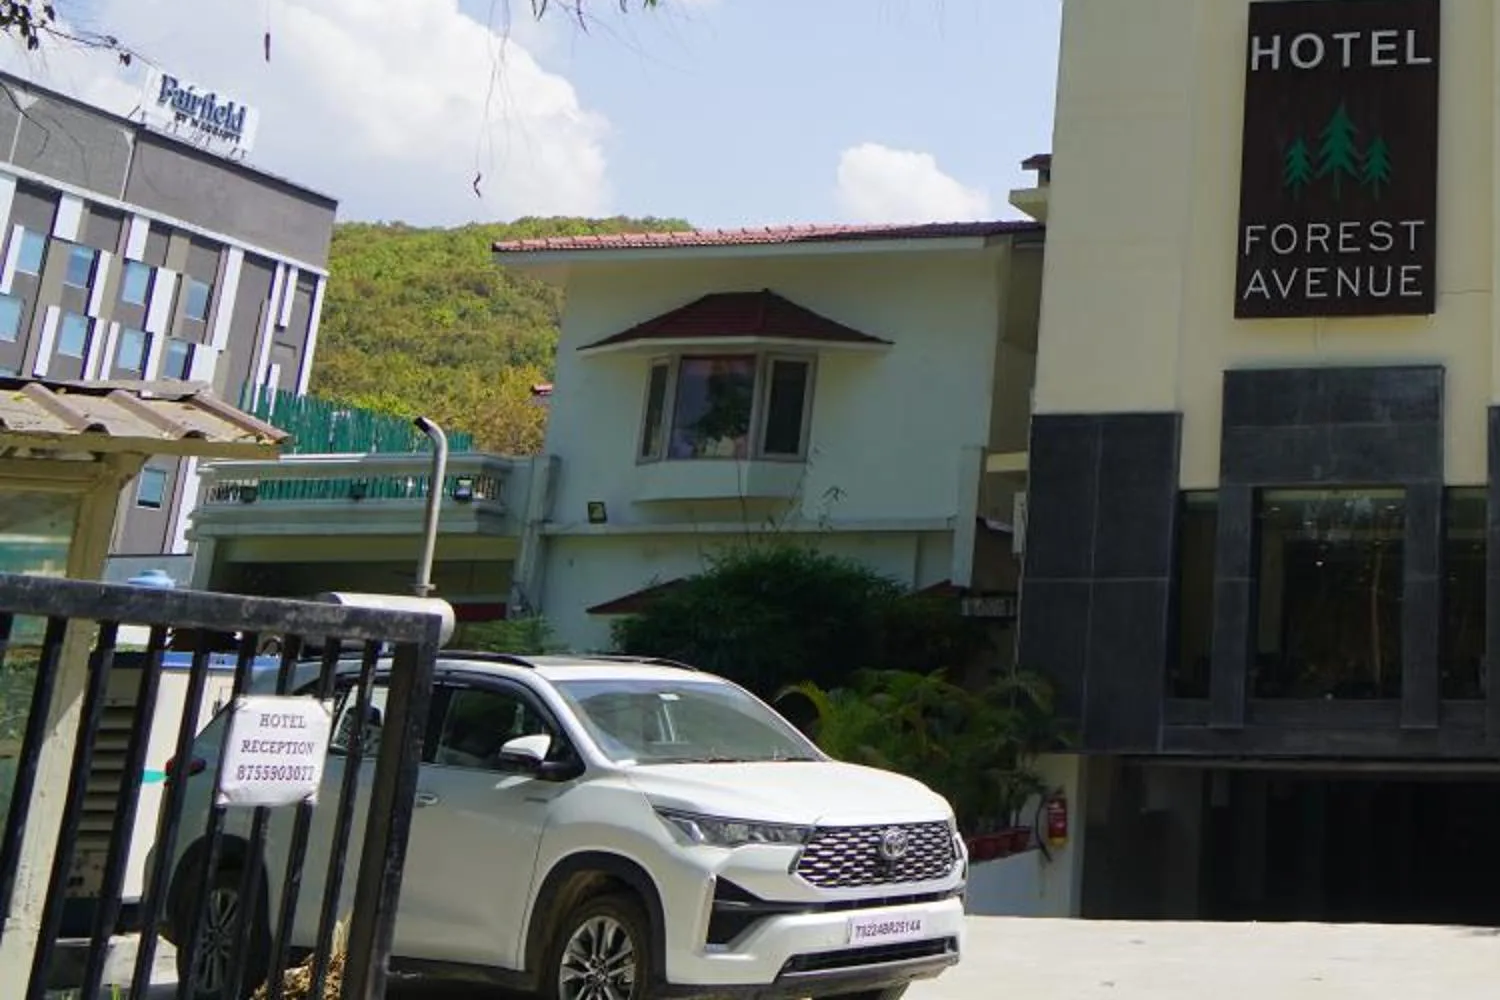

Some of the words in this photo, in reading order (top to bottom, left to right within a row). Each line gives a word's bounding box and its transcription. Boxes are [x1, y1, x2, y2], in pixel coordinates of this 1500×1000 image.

[1250, 29, 1433, 71] HOTEL
[159, 74, 246, 134] Fairfield
[1244, 220, 1425, 256] FOREST
[1243, 265, 1423, 299] AVENUE
[259, 713, 306, 728] HOTEL
[241, 739, 315, 754] RECEPTION
